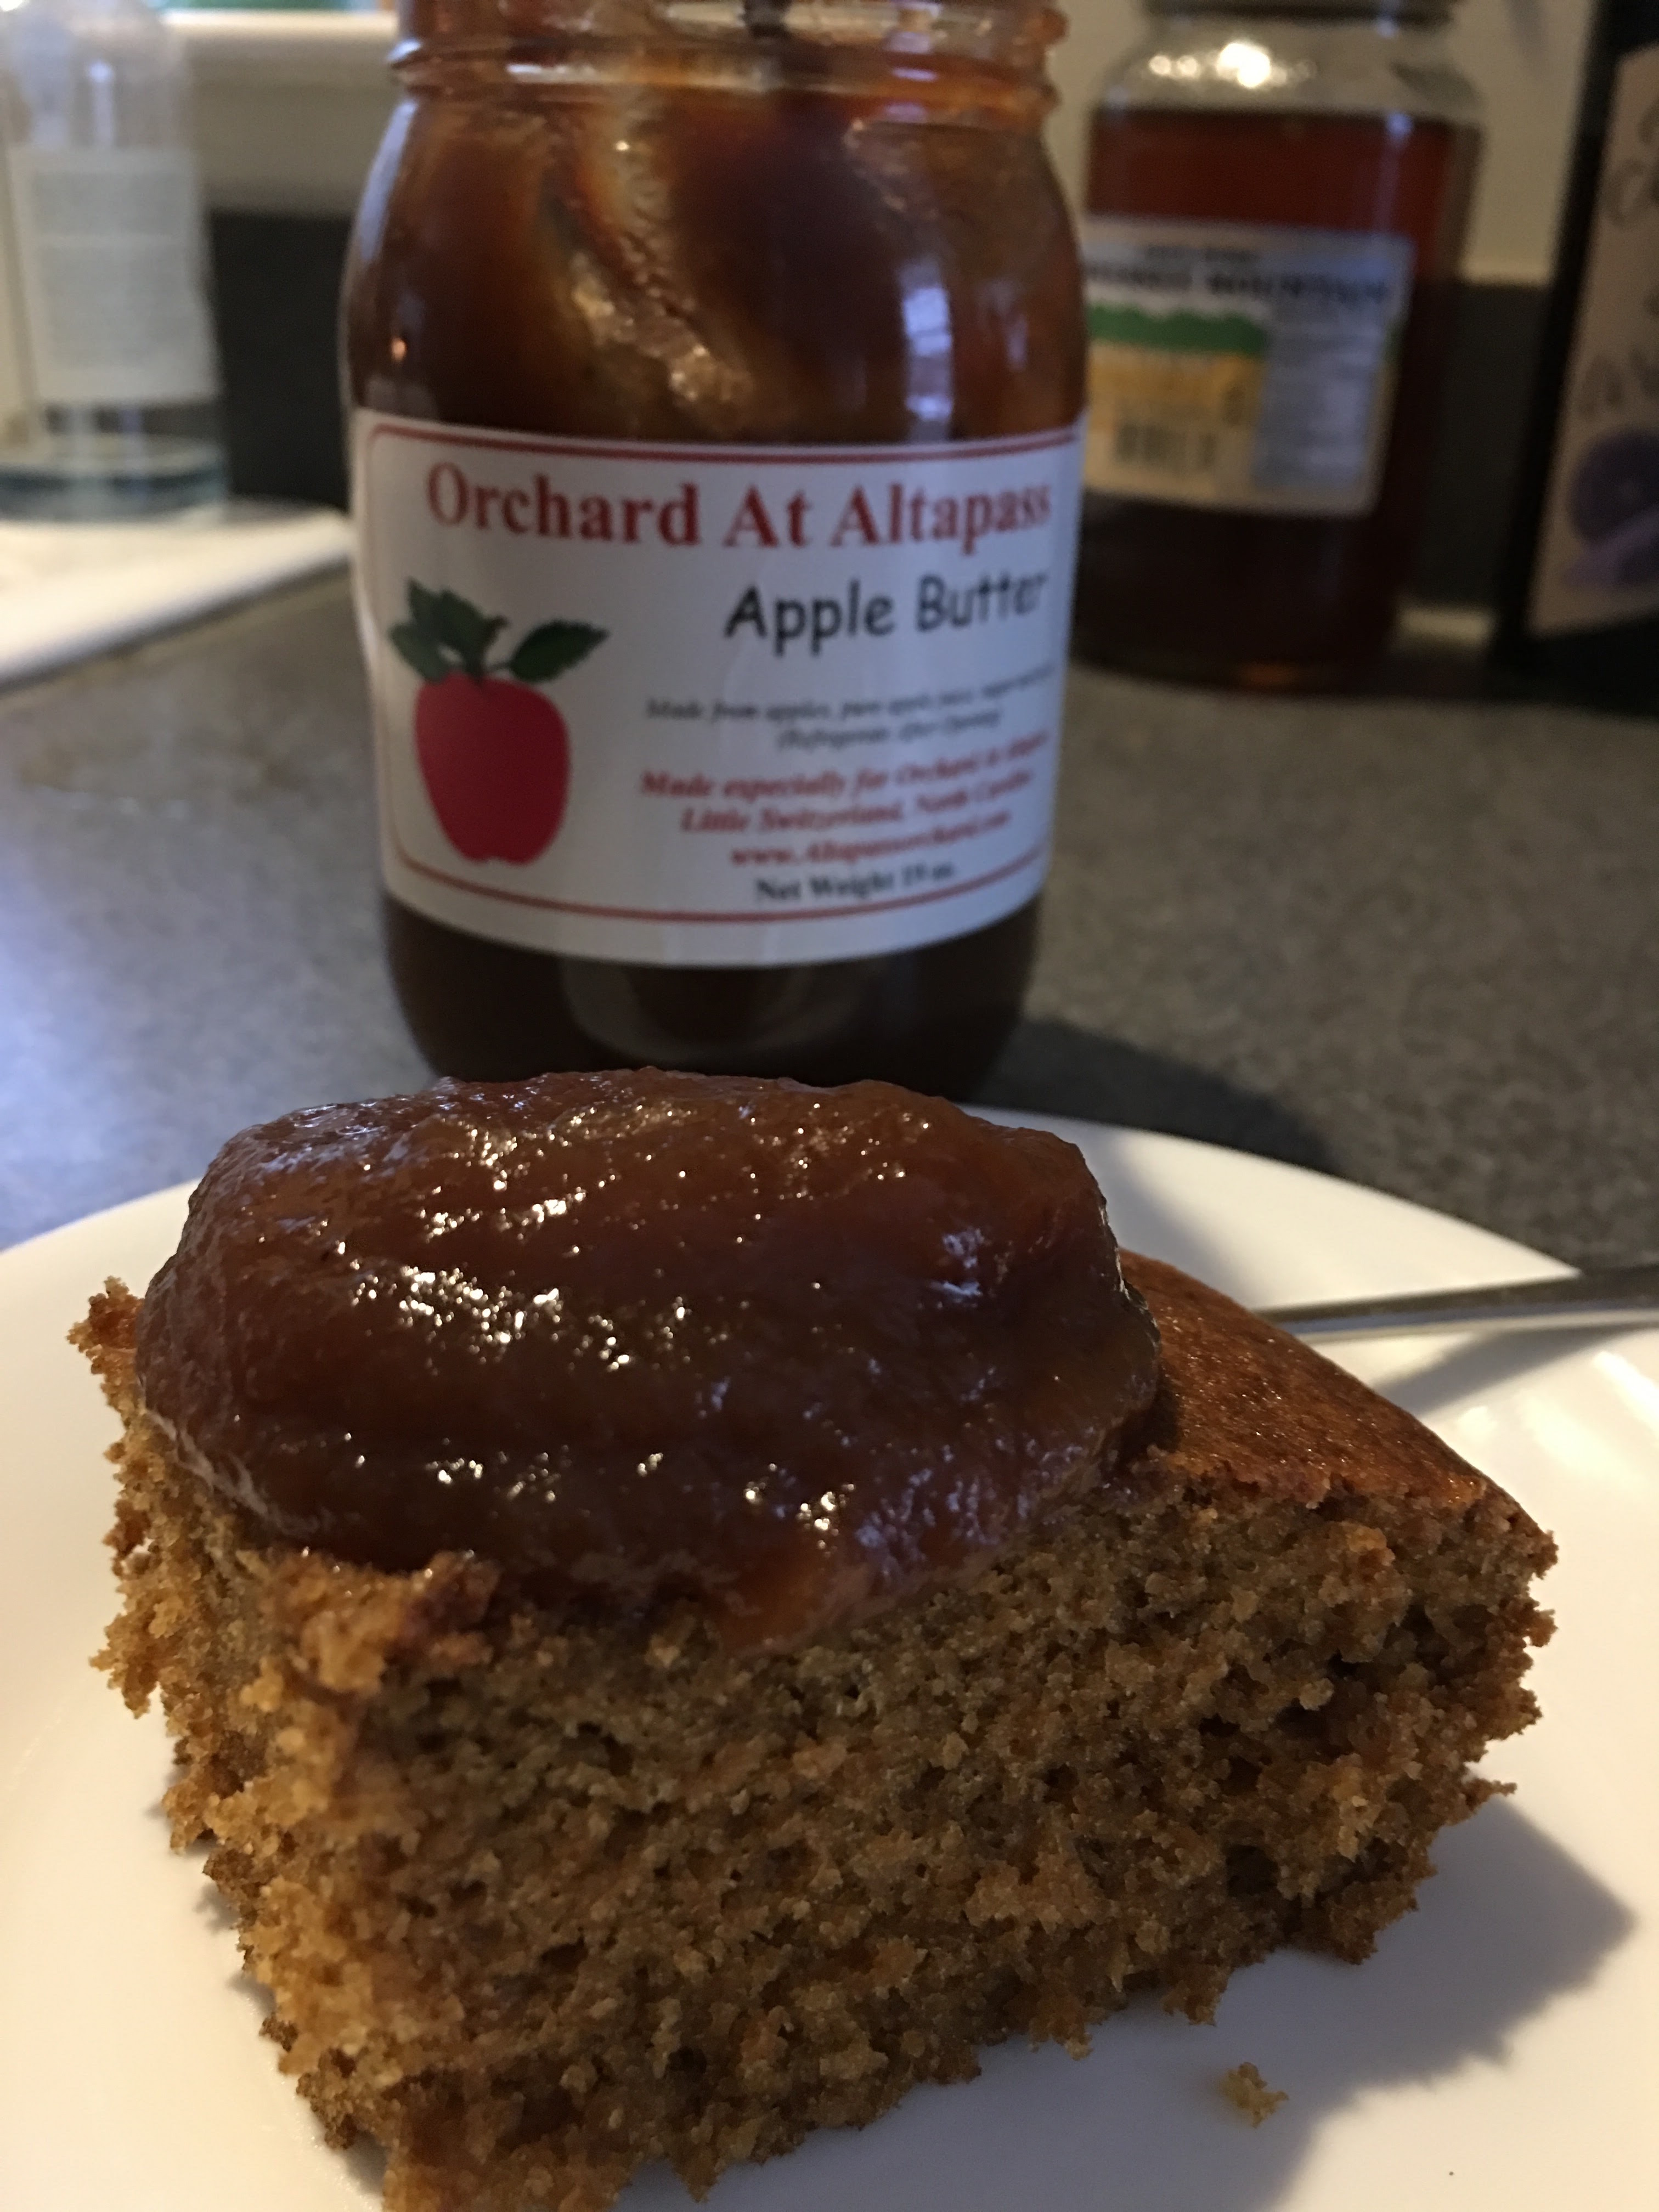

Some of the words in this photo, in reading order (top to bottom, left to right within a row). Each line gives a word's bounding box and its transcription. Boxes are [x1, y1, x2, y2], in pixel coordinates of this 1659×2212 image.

[426, 462, 699, 547] Orchard
[724, 484, 811, 548] At
[832, 481, 1051, 555] Altapass
[724, 580, 895, 657] Apple
[917, 572, 1048, 633] Butter
[641, 770, 715, 798] Made
[722, 770, 844, 802] especially
[853, 769, 888, 797] for
[680, 808, 751, 832] Little
[755, 877, 801, 900] Net
[810, 869, 894, 899] Weight
